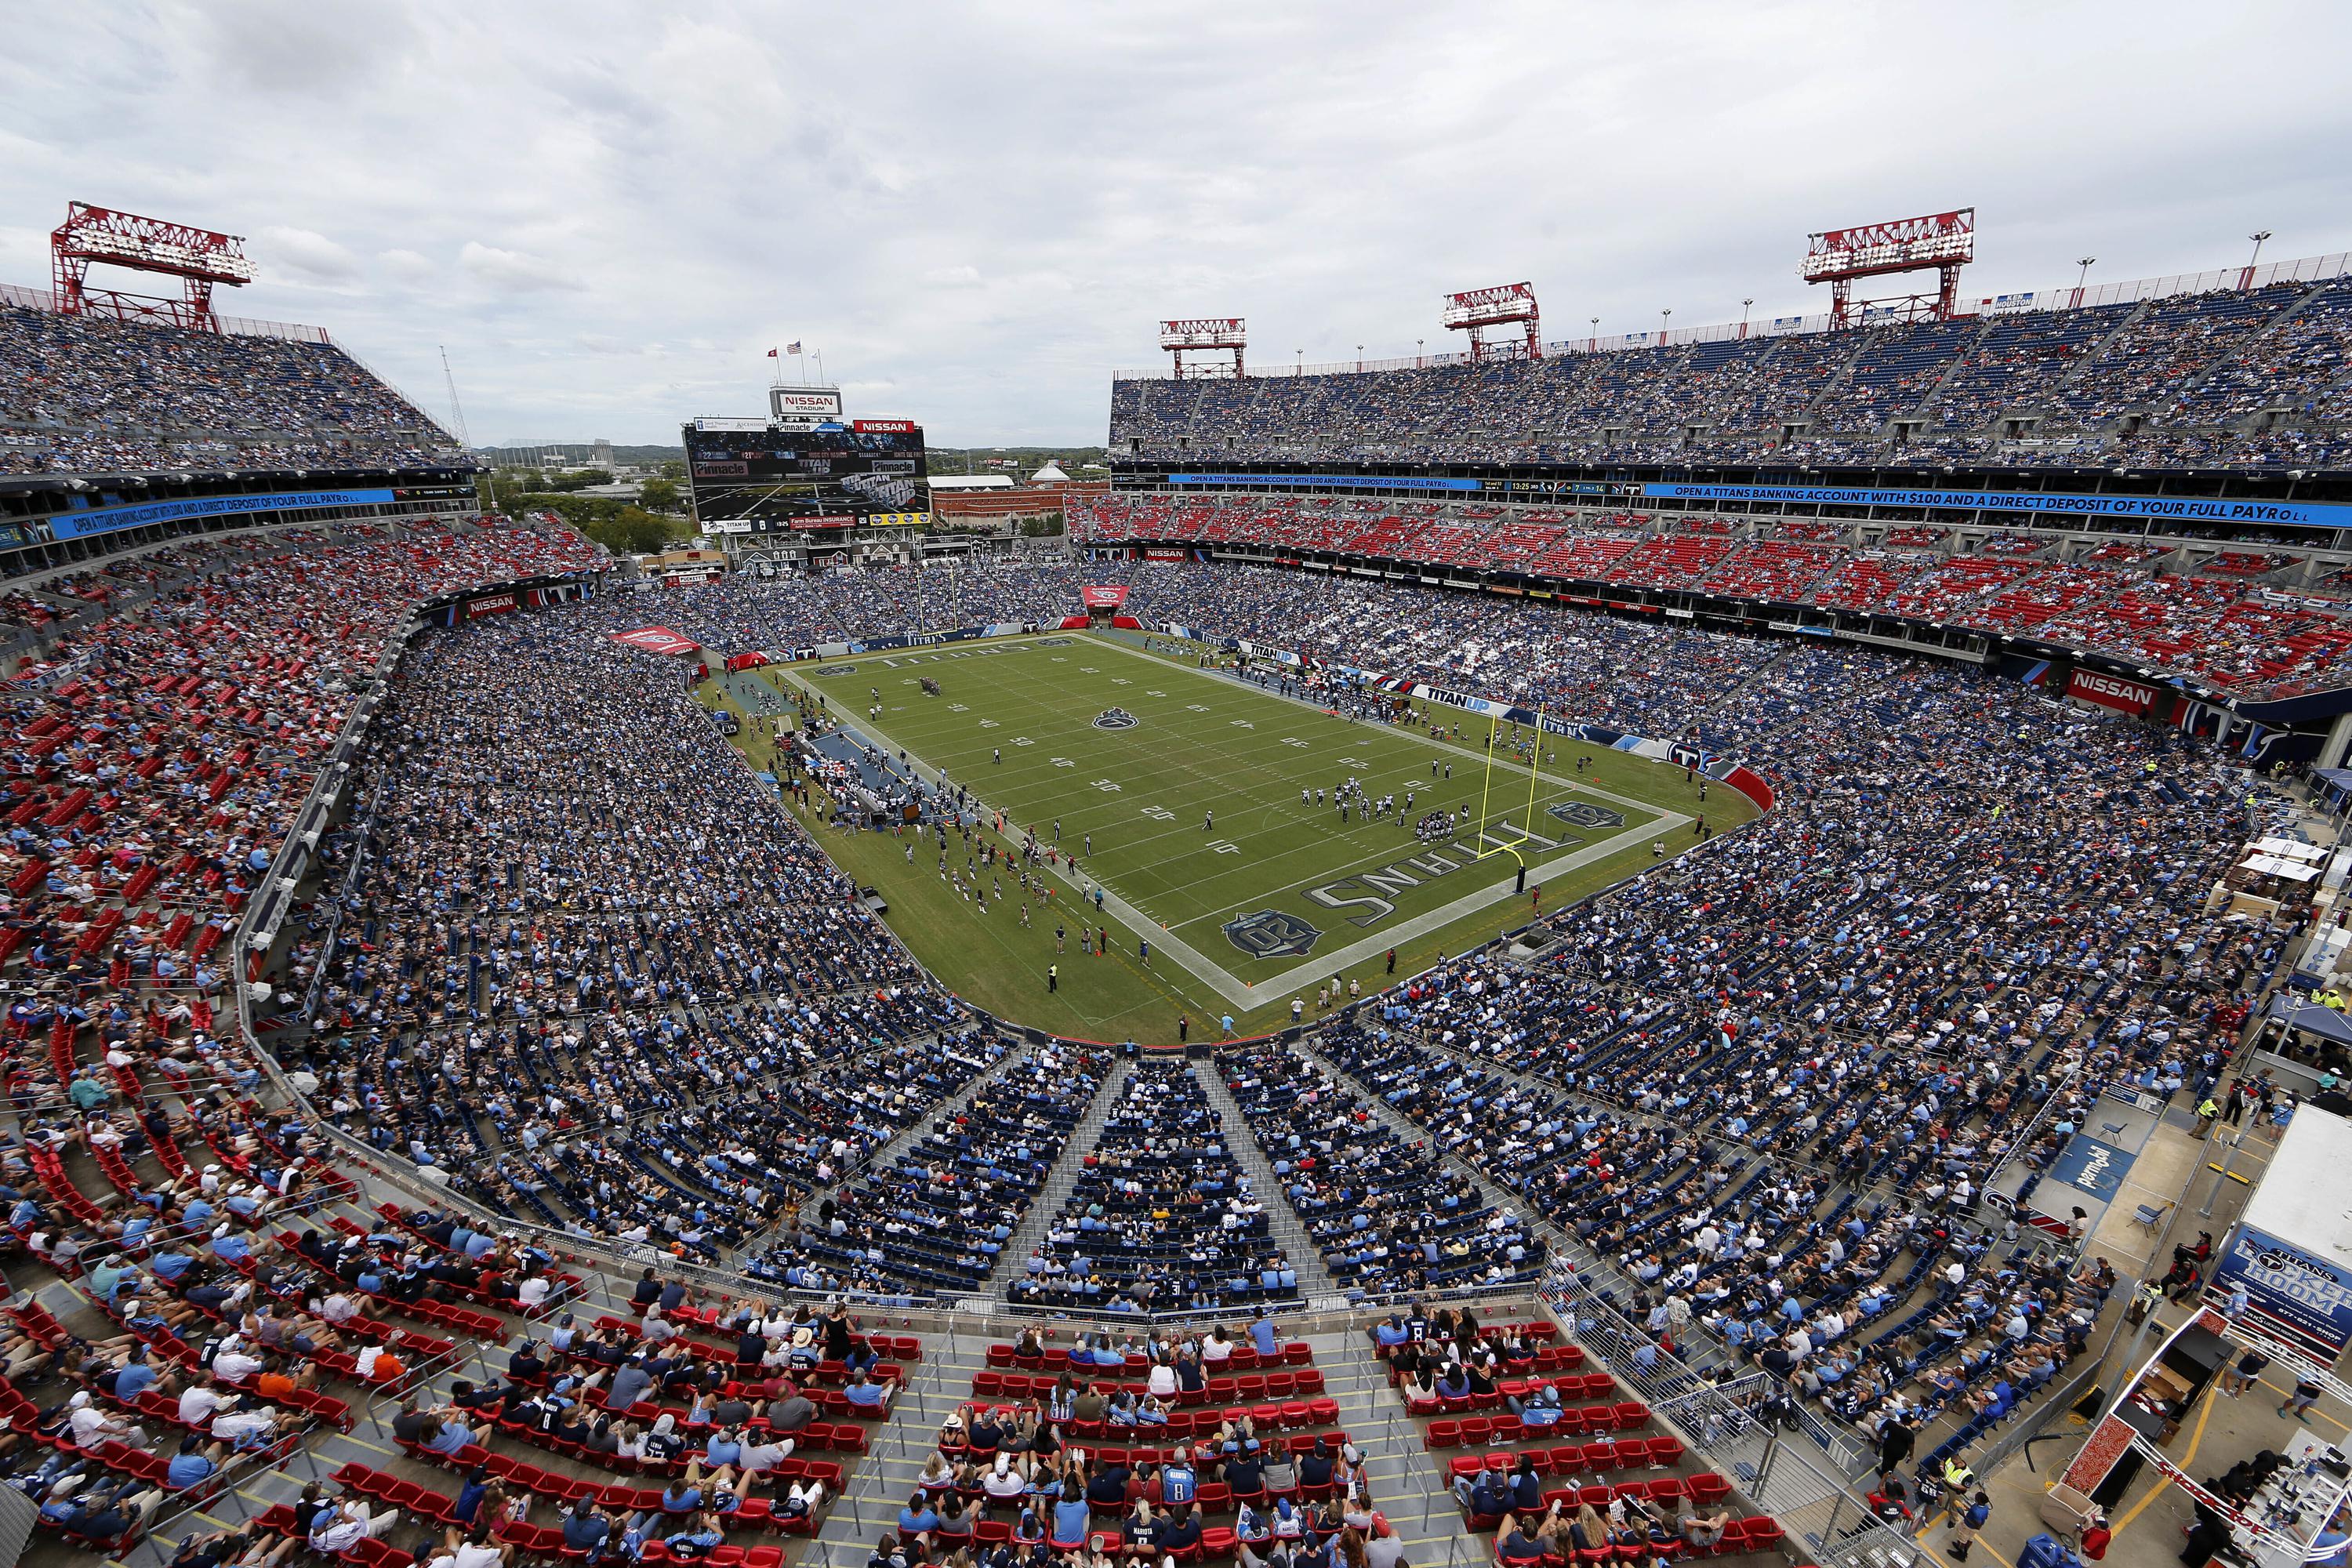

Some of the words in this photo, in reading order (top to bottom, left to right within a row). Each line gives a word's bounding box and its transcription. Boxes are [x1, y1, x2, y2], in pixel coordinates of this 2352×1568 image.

[1996, 299, 2031, 308] HOUSTON
[786, 397, 833, 405] NISSAN
[862, 423, 907, 431] NISSAN
[696, 463, 746, 474] Pinnacle
[873, 462, 913, 472] Pinnacle
[877, 479, 915, 498] TITAN
[1425, 479, 1453, 488] PAYROLL
[184, 503, 198, 514] AND
[203, 500, 226, 512] DIRECT
[227, 498, 260, 510] DEPOSIT
[260, 497, 272, 507] OF
[274, 495, 296, 506] YOUR
[299, 495, 321, 505] FULL
[321, 492, 361, 504] PAYROLL
[896, 488, 916, 506] UP
[1675, 487, 1702, 495] OPEN
[1703, 488, 1711, 496] A
[1712, 488, 1751, 498] TITANS
[1752, 489, 1804, 499] BANKING
[1806, 491, 1869, 501] ACCOUNT
[1871, 492, 1907, 503] WITH
[1907, 492, 1943, 504] $100
[1944, 494, 1974, 506] AND
[1976, 495, 1987, 506] A
[1988, 496, 2045, 509] DIRECT
[2045, 498, 2112, 511] DEPOSIT
[2113, 499, 2139, 511] OF
[2140, 500, 2186, 515] YOUR
[2187, 503, 2227, 517] FULL
[2230, 504, 2309, 521] PAYROLL
[470, 597, 514, 612] NISSAN
[1769, 622, 1795, 630] Pinnacle
[907, 634, 946, 646] TITANS
[866, 643, 1034, 669] TITANS
[2073, 672, 2153, 705] NISSAN
[1010, 737, 1036, 746] 50
[1280, 737, 1308, 747] 30
[1050, 758, 1073, 768] 40
[1337, 757, 1368, 769] 20
[1090, 779, 1120, 792] 30
[1140, 806, 1174, 820] 20
[1205, 839, 1238, 854] 10
[1301, 818, 1585, 928] TITANS
[2077, 1145, 2111, 1189] permobil
[2276, 1249, 2334, 1283] TITANS
[1172, 1285, 1180, 1295] 31
[2244, 1259, 2338, 1316] ROOM
[1414, 1327, 1423, 1341] 8
[1896, 1356, 1904, 1367] 8
[543, 1413, 550, 1429] 8
[1170, 1471, 1188, 1479] MARIOTA
[1174, 1483, 1185, 1501] 8
[677, 1544, 693, 1553] MARIOTA
